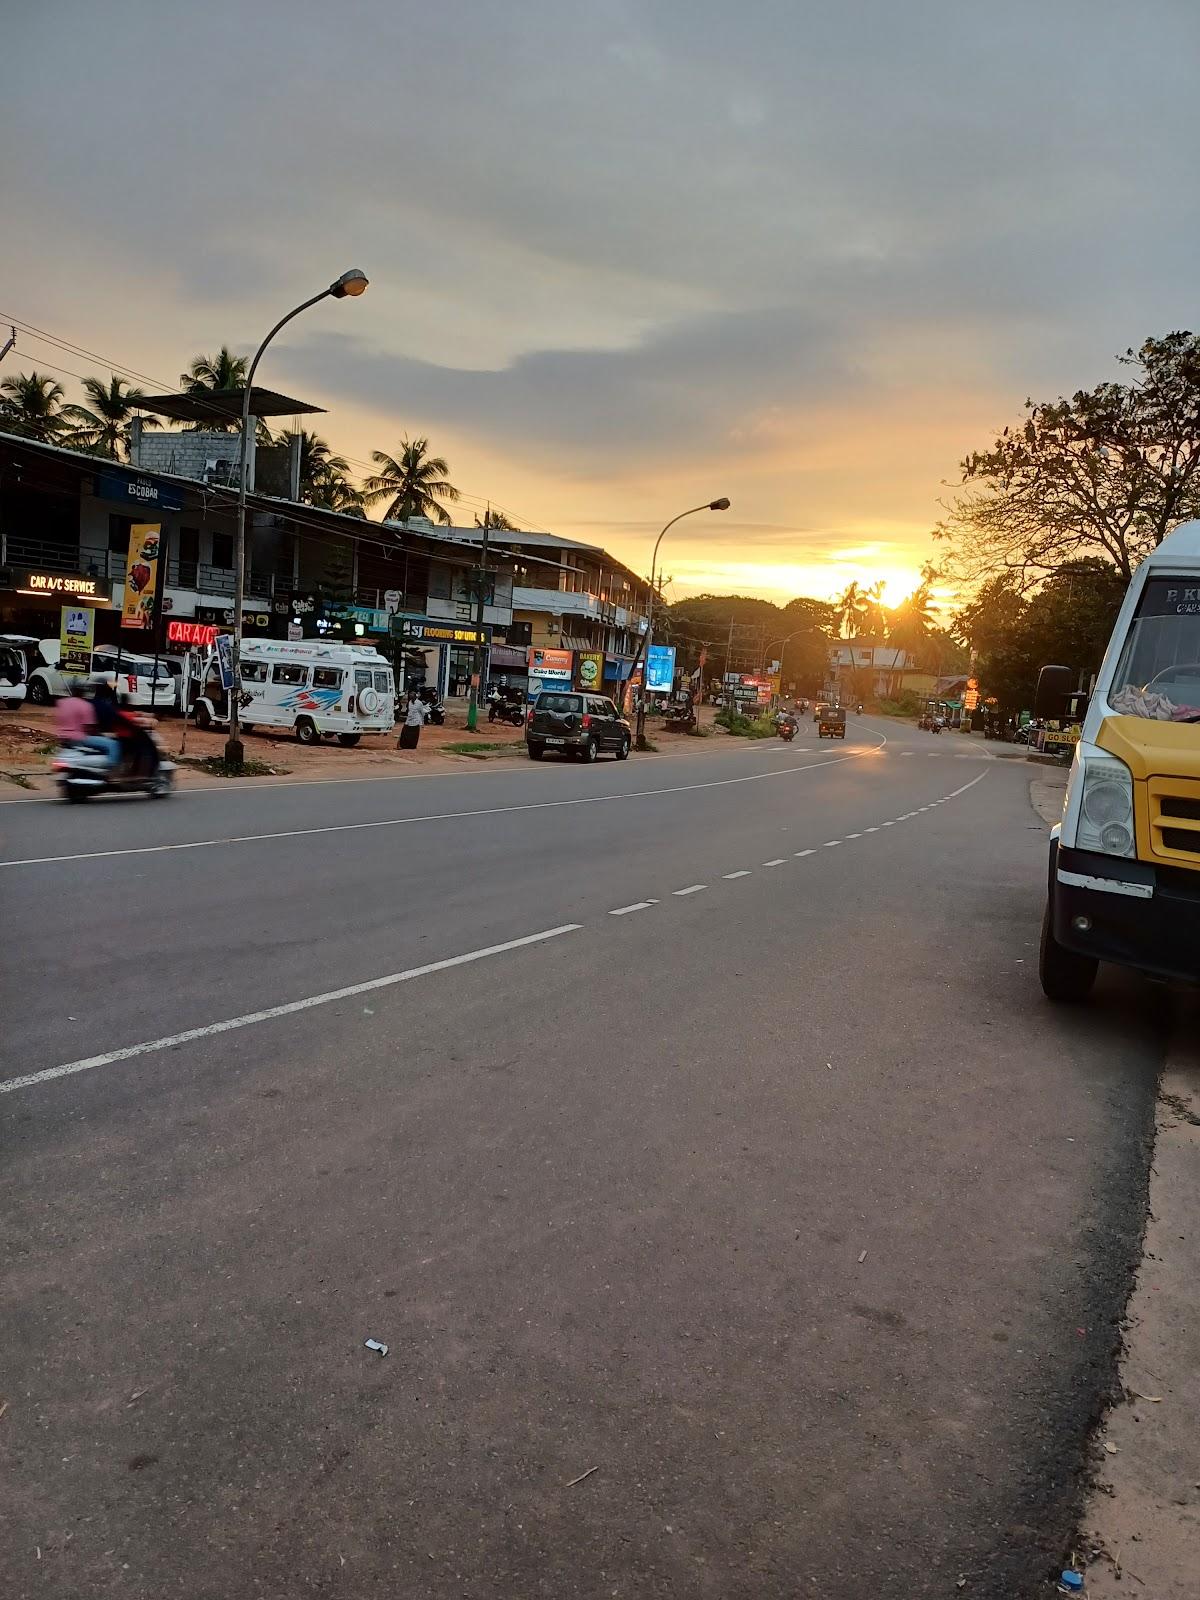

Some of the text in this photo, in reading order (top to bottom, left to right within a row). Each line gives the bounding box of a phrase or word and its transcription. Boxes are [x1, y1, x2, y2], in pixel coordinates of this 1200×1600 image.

[128, 483, 159, 500] ESCOBAR
[30, 575, 96, 594] CAR A/C SERVICE
[168, 621, 215, 646] CAR A/C
[411, 625, 424, 638] SJ
[424, 626, 454, 640] FLOORING
[579, 652, 601, 661] BAKERY
[548, 669, 567, 677] World
[1047, 733, 1060, 742] GO
